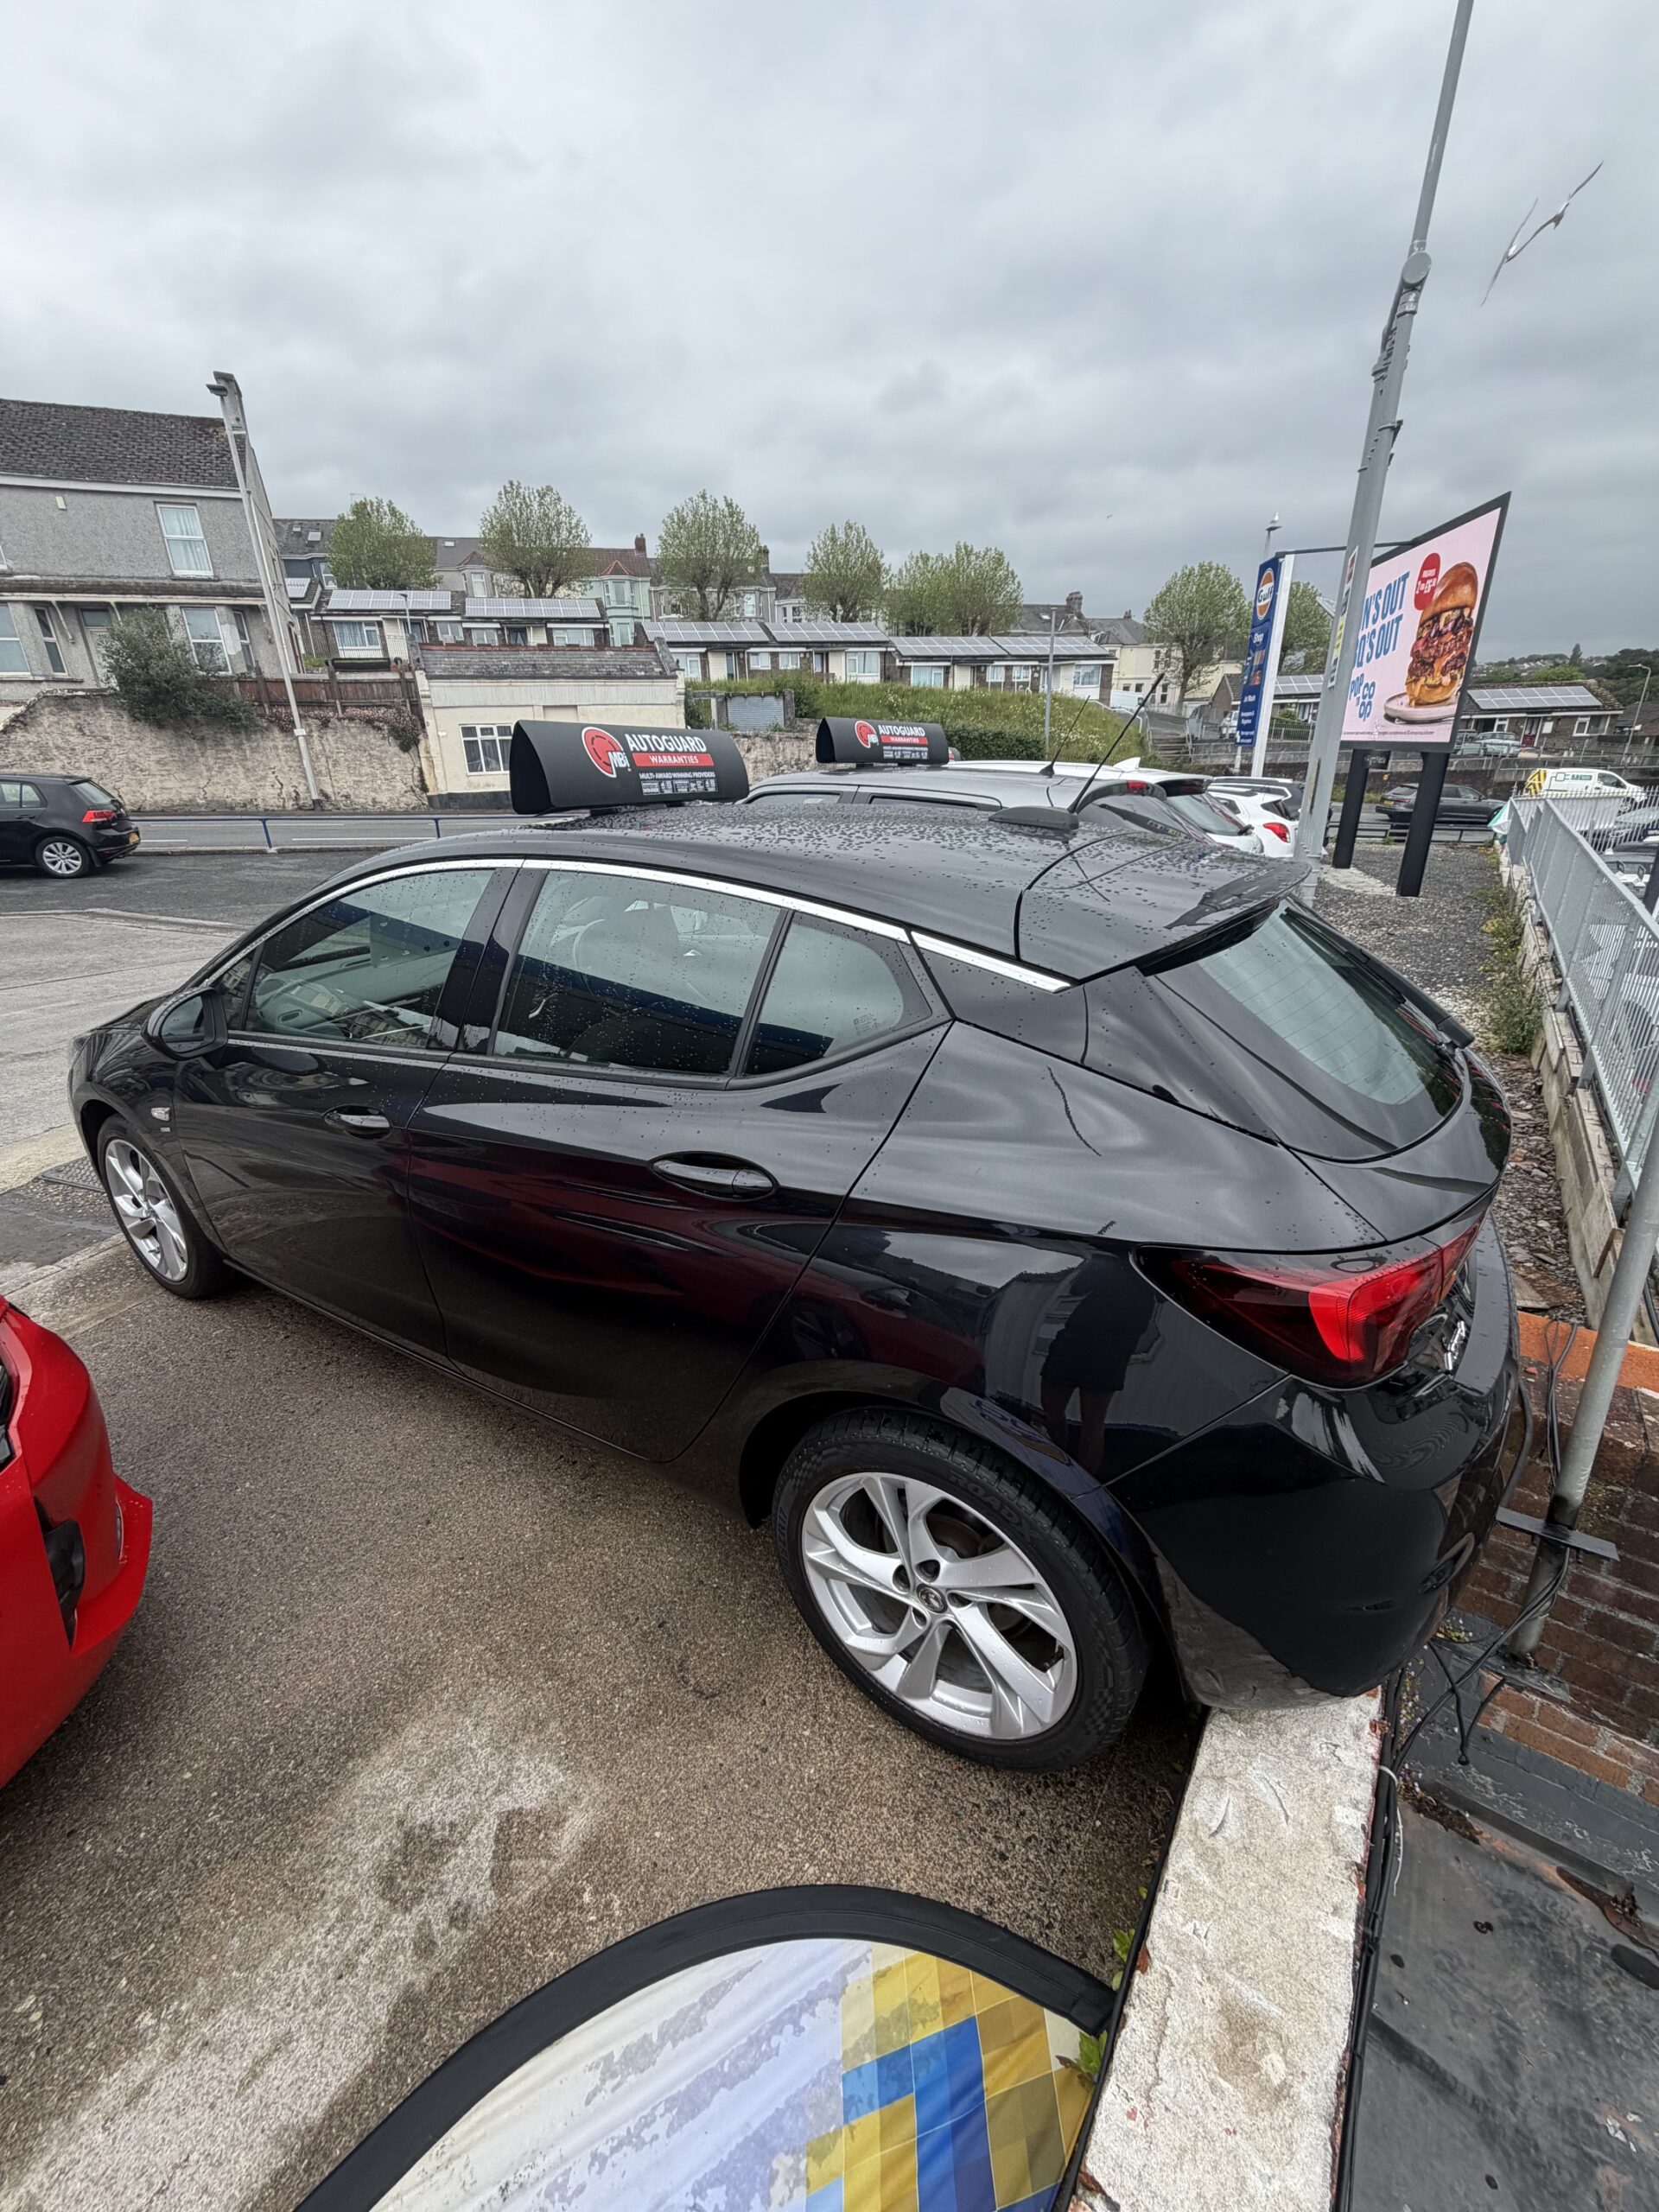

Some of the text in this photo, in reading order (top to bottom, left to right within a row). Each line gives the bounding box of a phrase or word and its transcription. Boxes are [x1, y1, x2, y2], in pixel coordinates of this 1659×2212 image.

[1258, 585, 1274, 603] Gulf
[1362, 571, 1410, 631] N'S OUT
[1375, 613, 1403, 659] OUT
[878, 725, 925, 736] AUTOGUARD
[625, 734, 707, 752] AUTOGUARD
[649, 755, 699, 764] WARRANTIES
